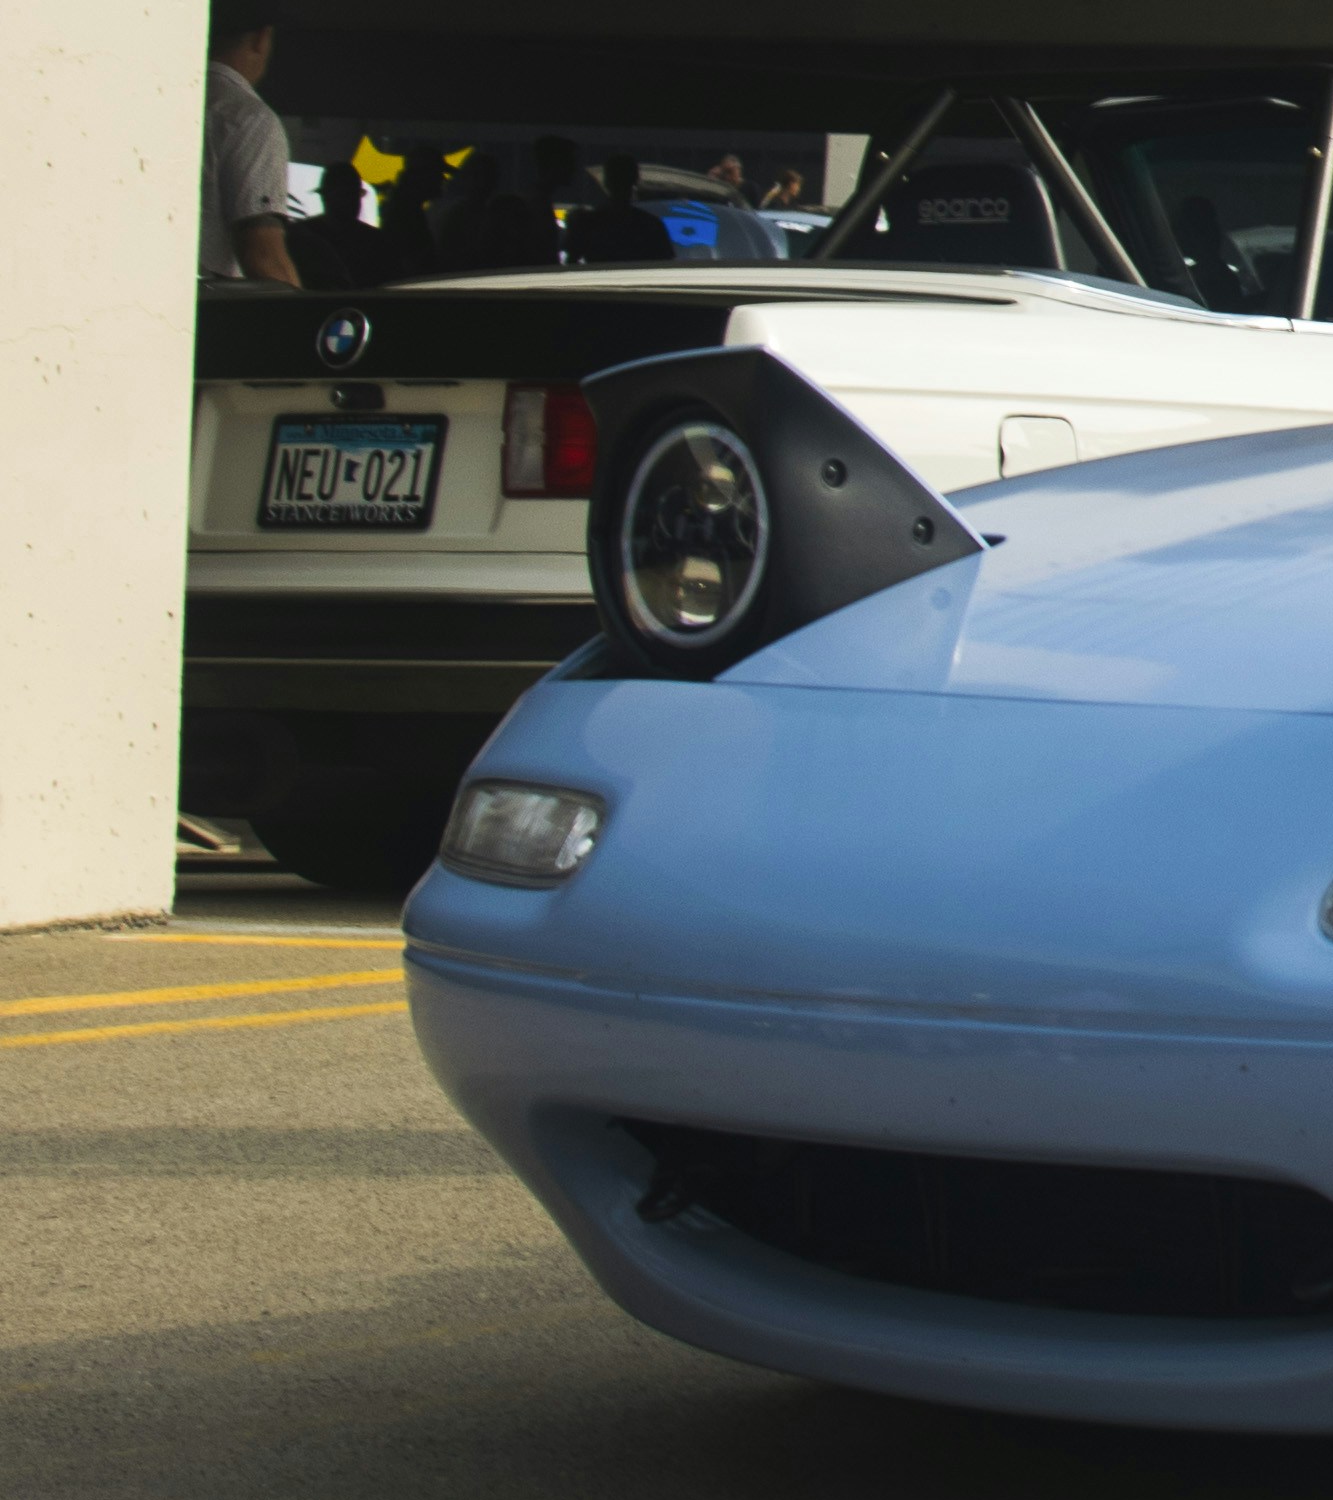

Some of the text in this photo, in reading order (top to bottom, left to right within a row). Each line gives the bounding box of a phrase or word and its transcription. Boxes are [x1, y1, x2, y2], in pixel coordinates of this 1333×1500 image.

[917, 197, 1010, 223] sparco
[275, 448, 422, 502] NEU 021
